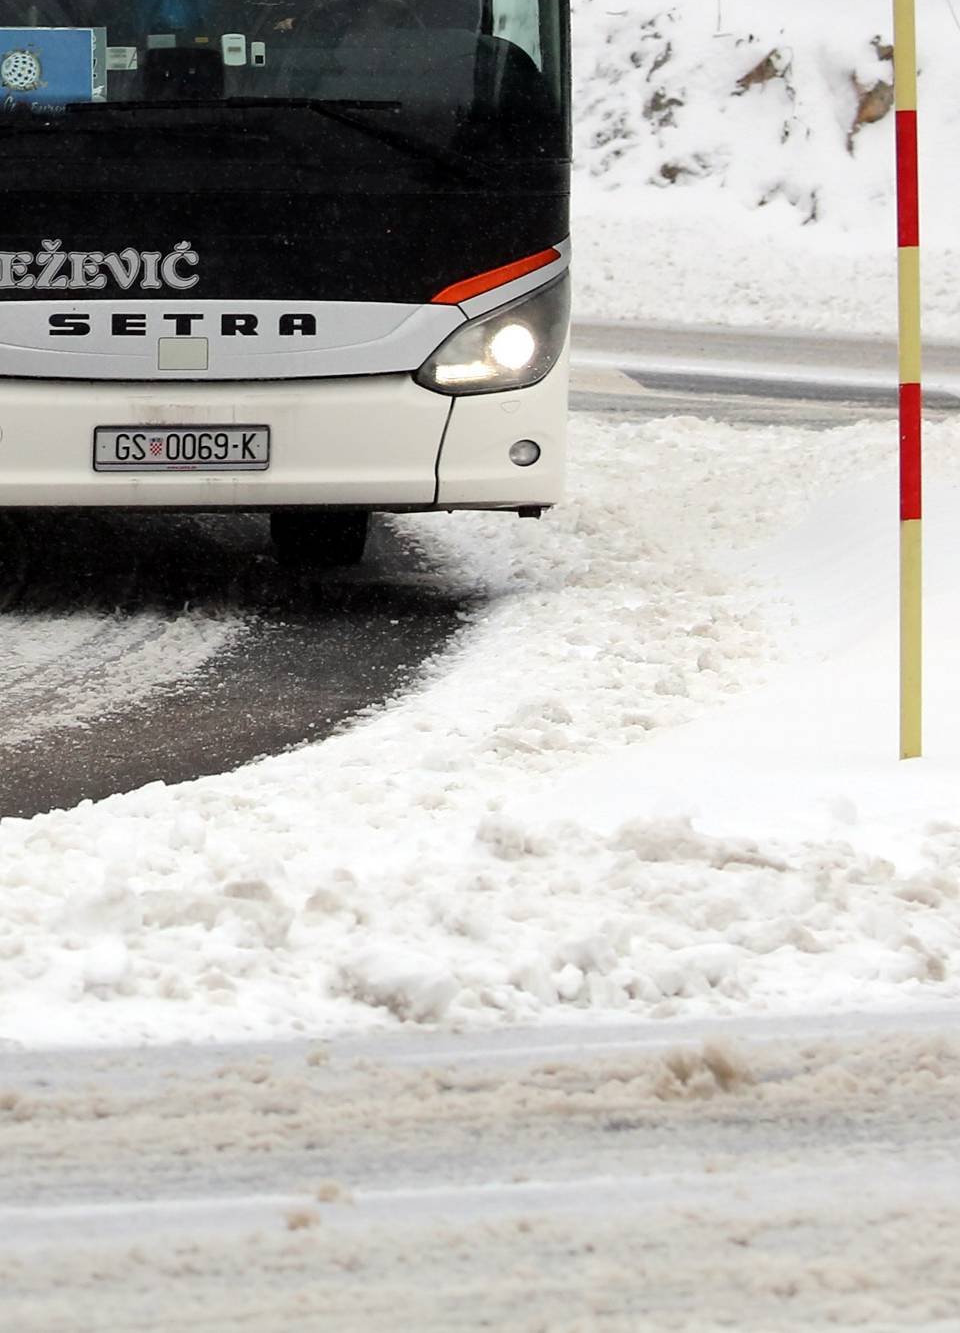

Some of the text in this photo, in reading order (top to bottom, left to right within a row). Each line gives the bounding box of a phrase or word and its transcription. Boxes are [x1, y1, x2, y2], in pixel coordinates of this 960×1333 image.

[48, 313, 316, 336] SETRA
[115, 432, 256, 460] GS 0069-K
